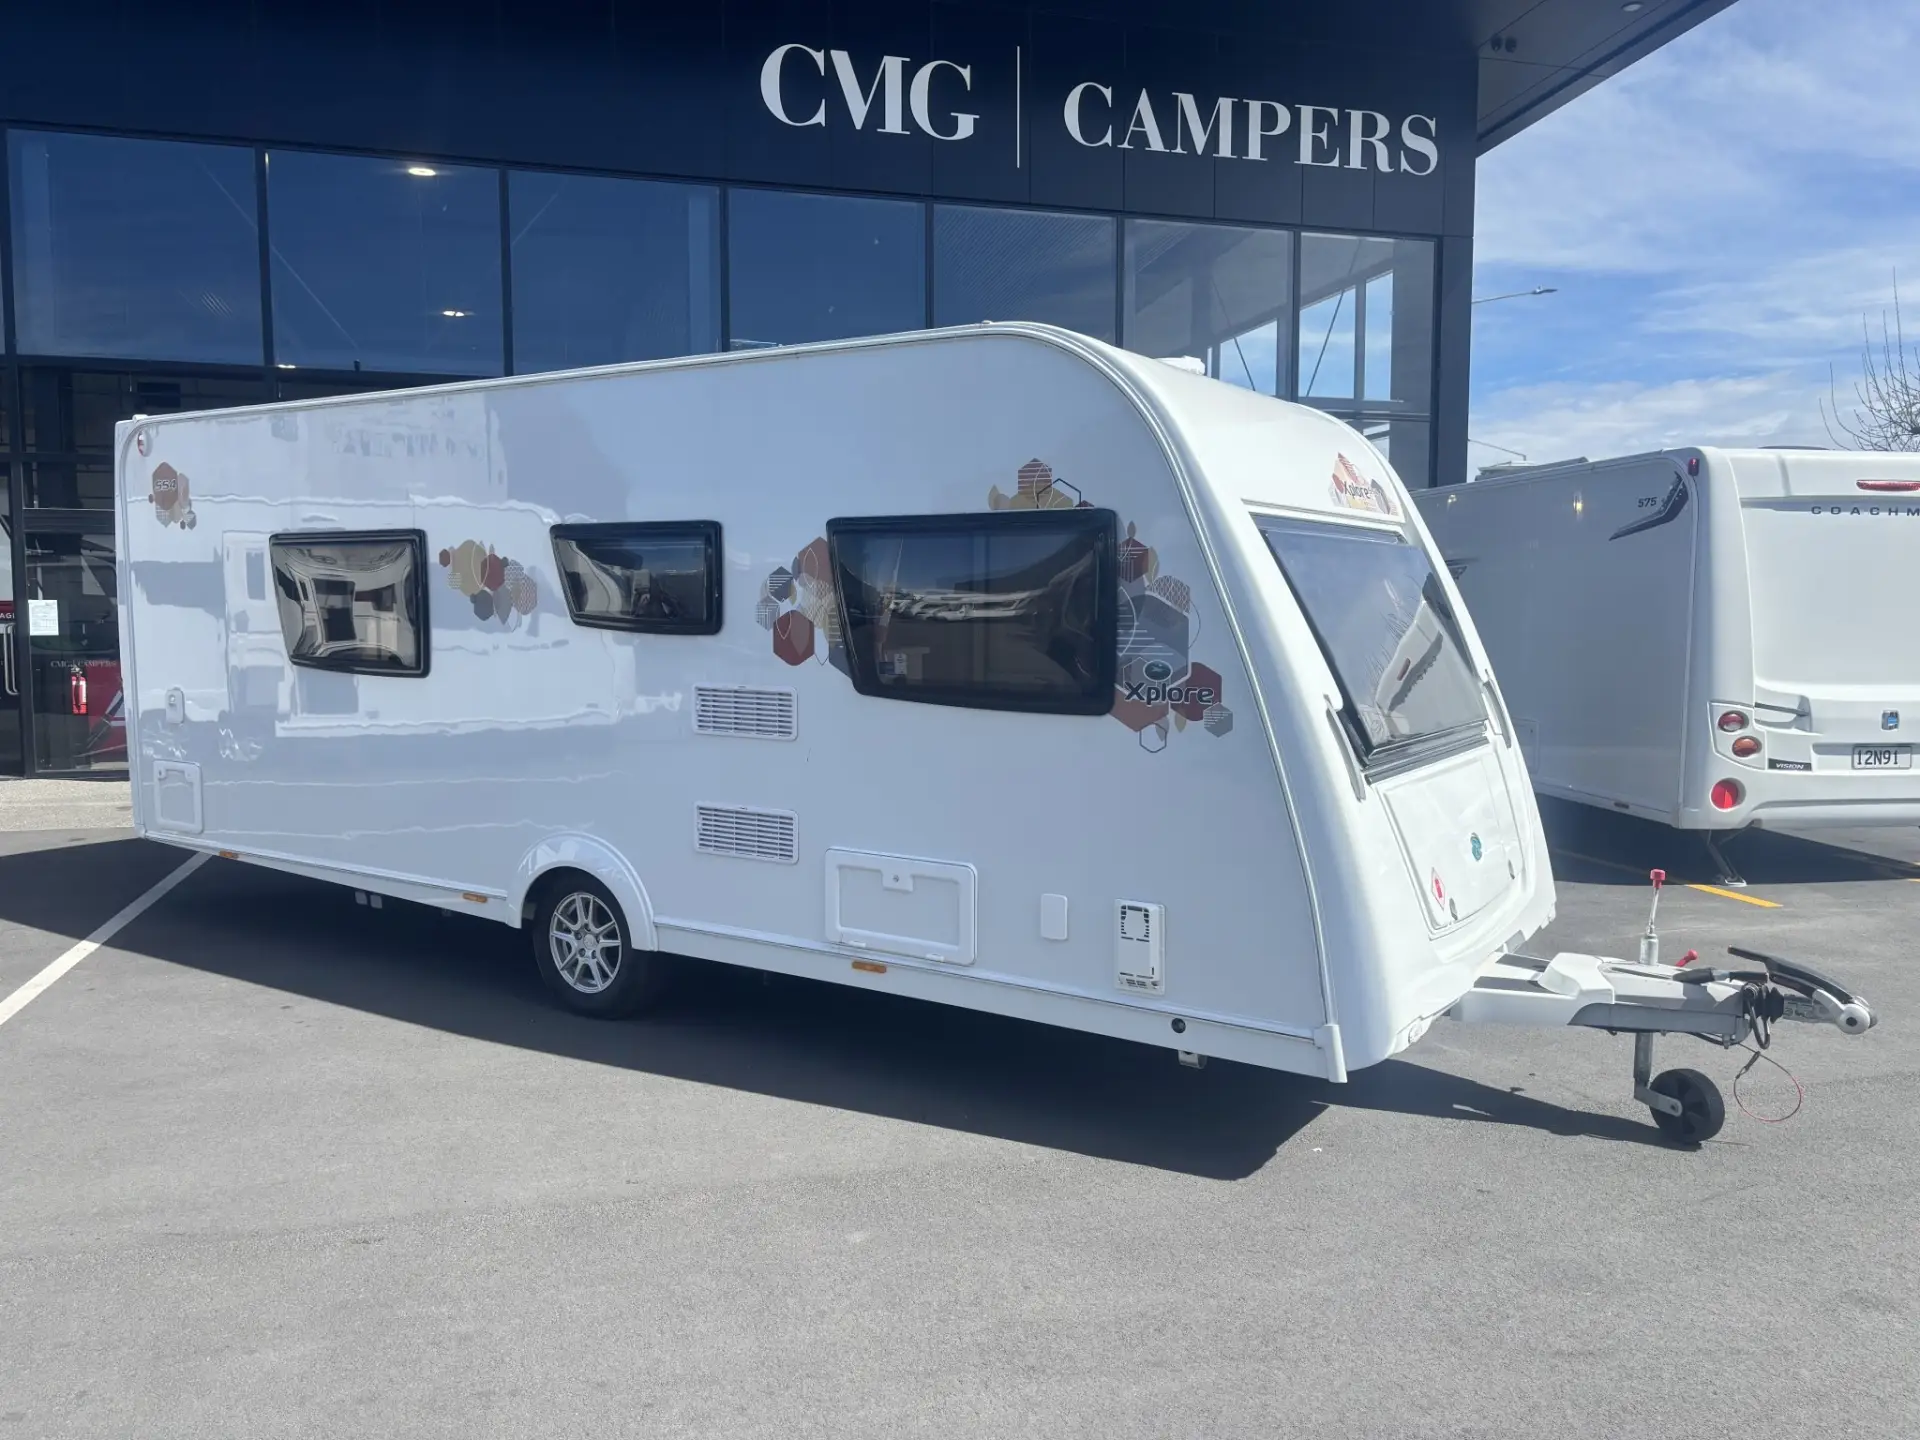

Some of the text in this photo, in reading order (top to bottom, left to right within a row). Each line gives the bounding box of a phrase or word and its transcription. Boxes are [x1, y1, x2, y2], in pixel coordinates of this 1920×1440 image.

[760, 43, 1439, 176] CMG CAMPERS
[155, 478, 177, 491] 554
[1343, 480, 1371, 499] Xplore
[1637, 496, 1658, 508] 575
[1124, 681, 1215, 707] Xplore
[1775, 762, 1805, 770] VISION
